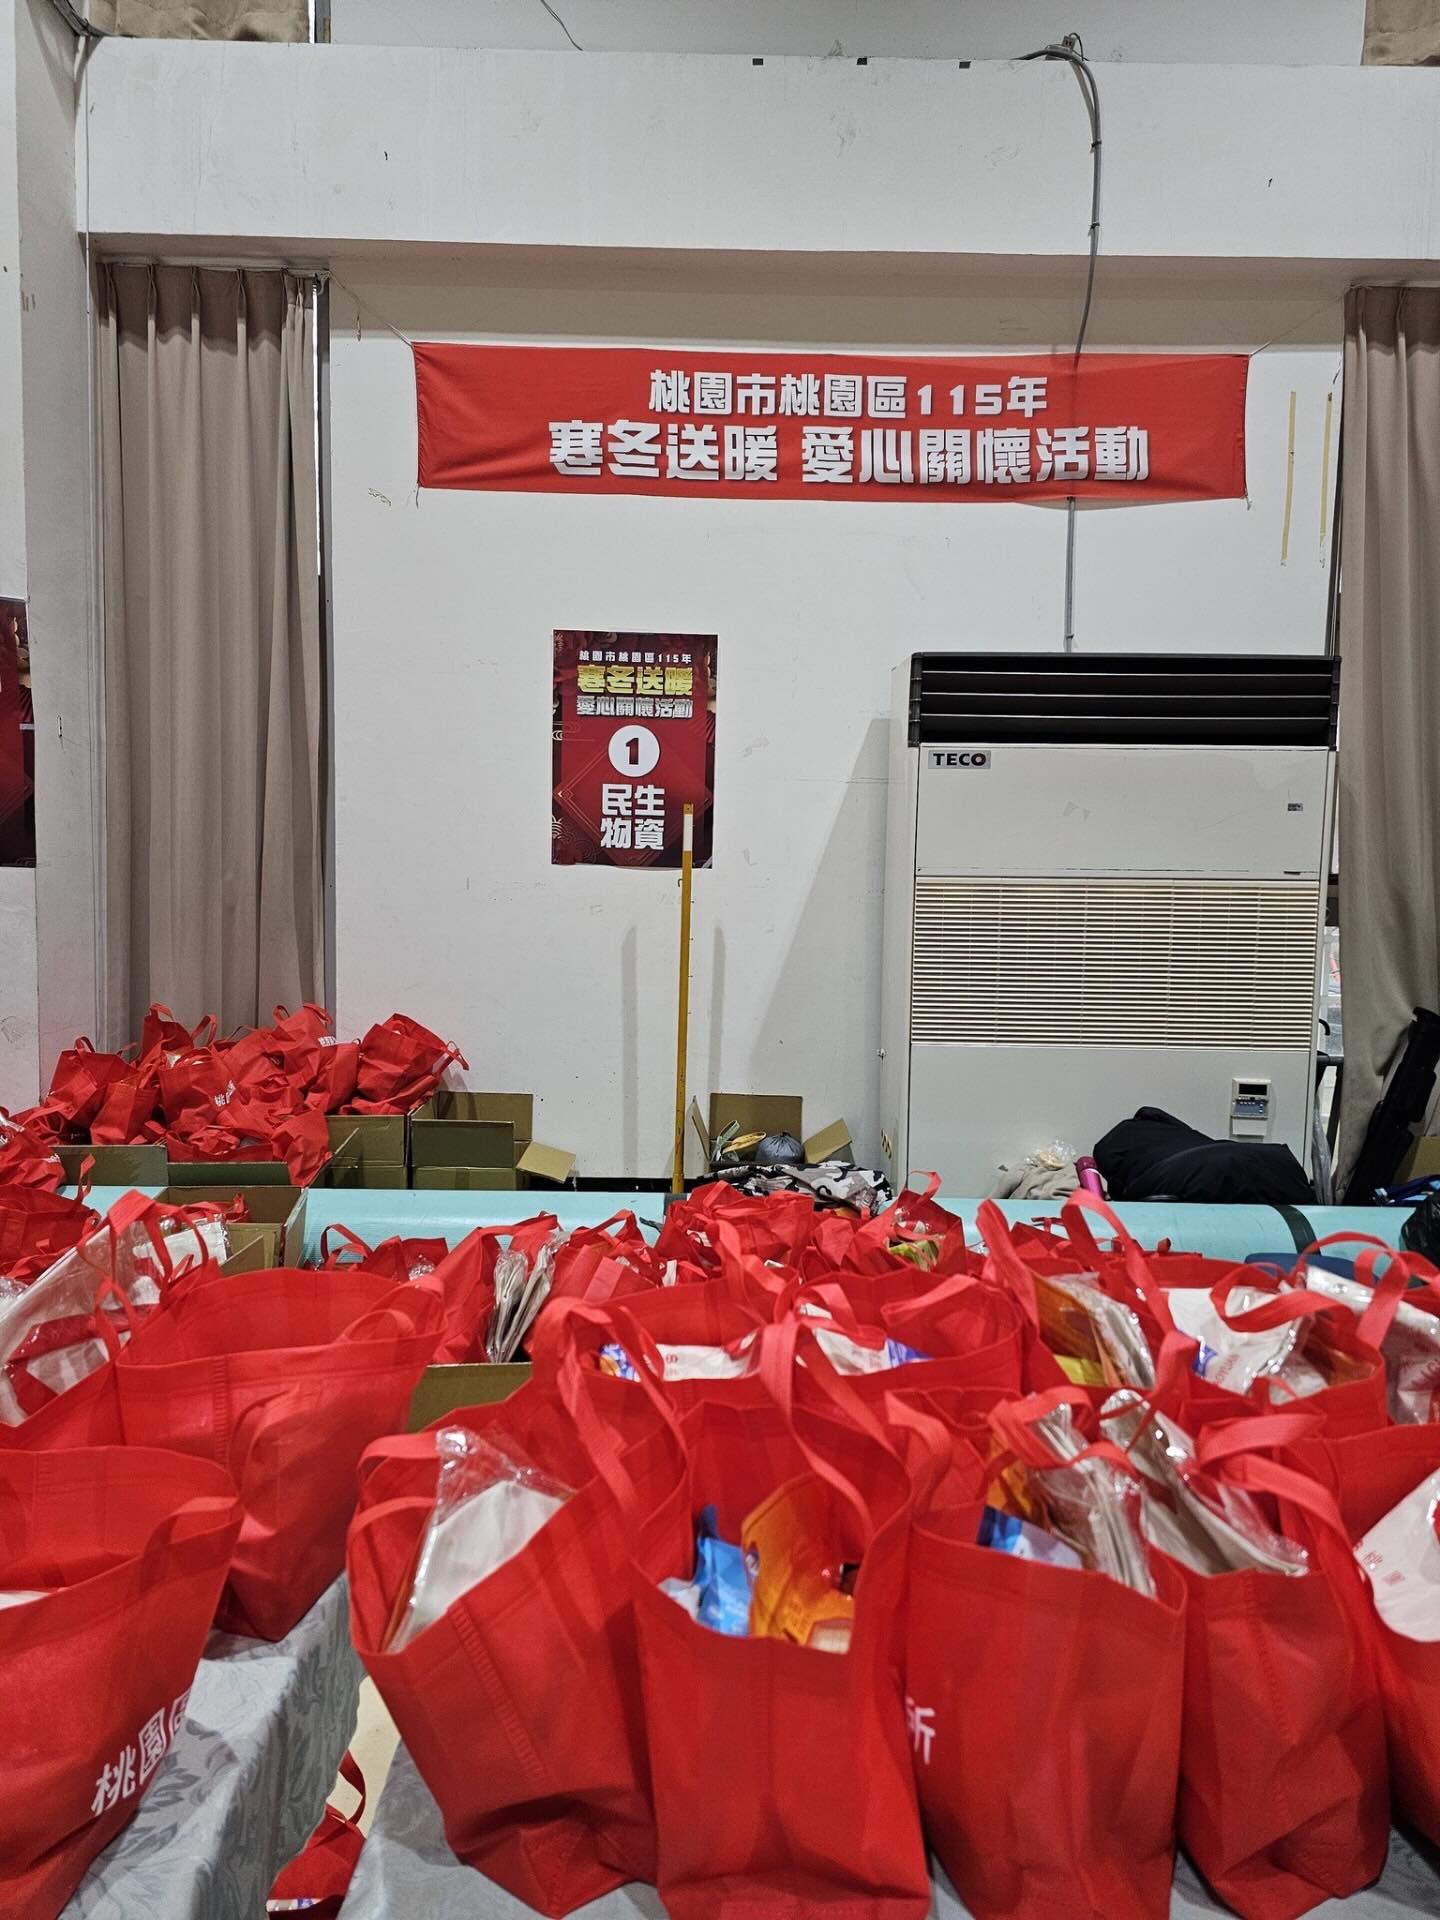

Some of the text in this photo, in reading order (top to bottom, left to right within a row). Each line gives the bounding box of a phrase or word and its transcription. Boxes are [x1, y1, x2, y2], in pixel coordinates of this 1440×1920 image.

[648, 369, 1048, 418] 桃園市桃園區115年
[549, 419, 1149, 484] 寒冬送暖 愛心關懷活動
[579, 650, 692, 664] 桃園市桃園區115年
[577, 664, 693, 696] 寒冬送暖
[577, 695, 693, 719] 愛心關懷活動
[625, 737, 640, 766] 1
[933, 753, 987, 766] TECO
[601, 783, 665, 816] 民生
[600, 817, 665, 850] 物資
